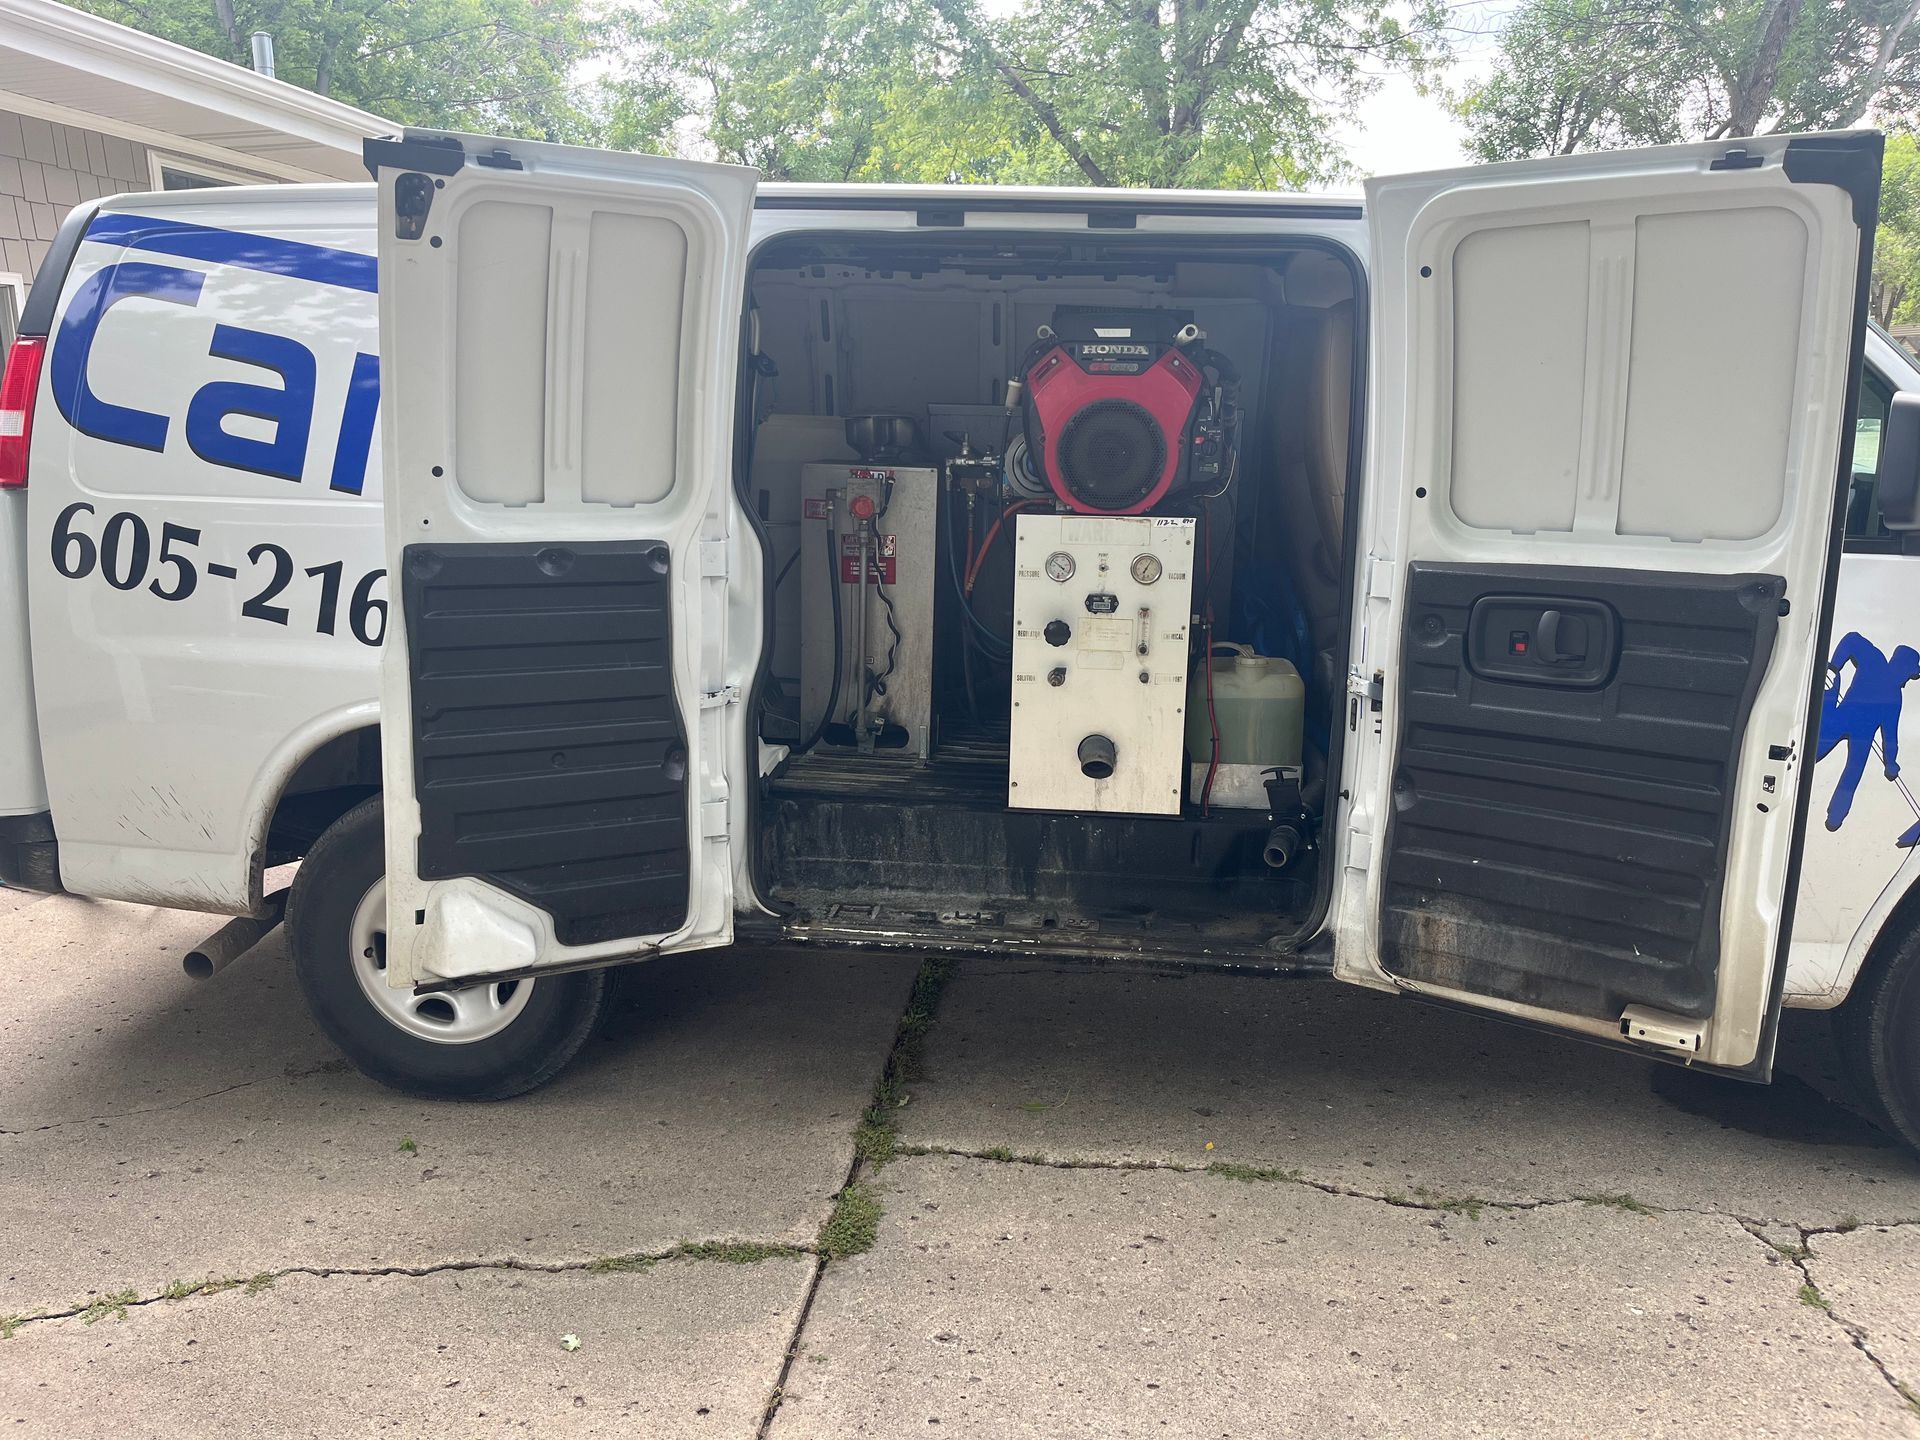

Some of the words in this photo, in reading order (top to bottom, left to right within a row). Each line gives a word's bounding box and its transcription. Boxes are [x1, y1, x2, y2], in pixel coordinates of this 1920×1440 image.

[1082, 344, 1150, 356] HONDA
[51, 502, 388, 647] 605-216
[1018, 570, 1040, 578] PRESSURE
[1168, 572, 1186, 580] VACUUM
